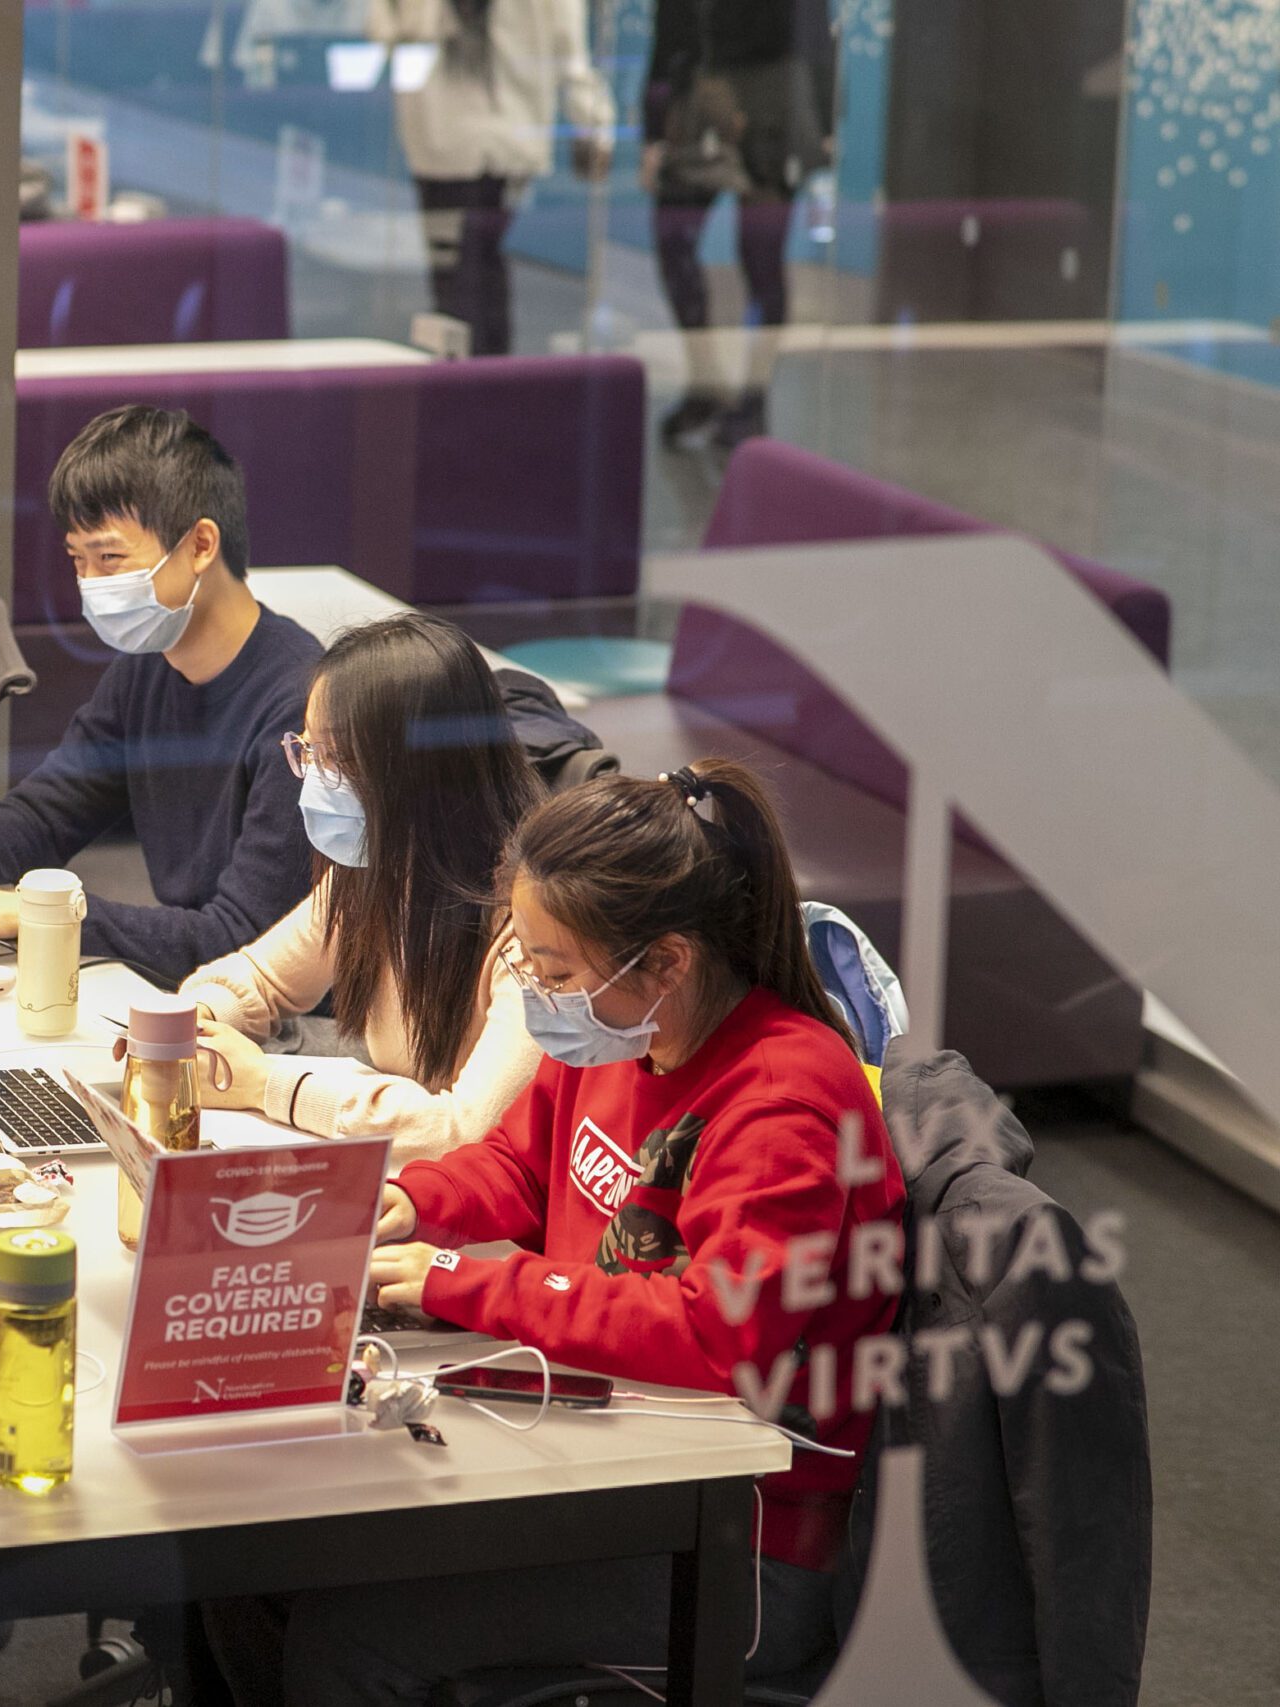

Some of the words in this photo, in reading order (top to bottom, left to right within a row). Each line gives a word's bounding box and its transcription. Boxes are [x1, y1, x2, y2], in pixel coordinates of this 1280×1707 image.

[216, 1164, 272, 1179] COVID-19
[273, 1161, 330, 1175] Response
[211, 1261, 293, 1289] FACE
[708, 1212, 1128, 1328] VERITAS
[164, 1282, 328, 1317] COVERING
[164, 1308, 323, 1342] REQUIRED
[144, 1360, 177, 1371] Please
[178, 1359, 191, 1368] be
[192, 1354, 229, 1366] mindful
[230, 1352, 244, 1364] of
[243, 1350, 279, 1362] healthy
[732, 1320, 1096, 1425] VIRTVS
[192, 1378, 225, 1404] N
